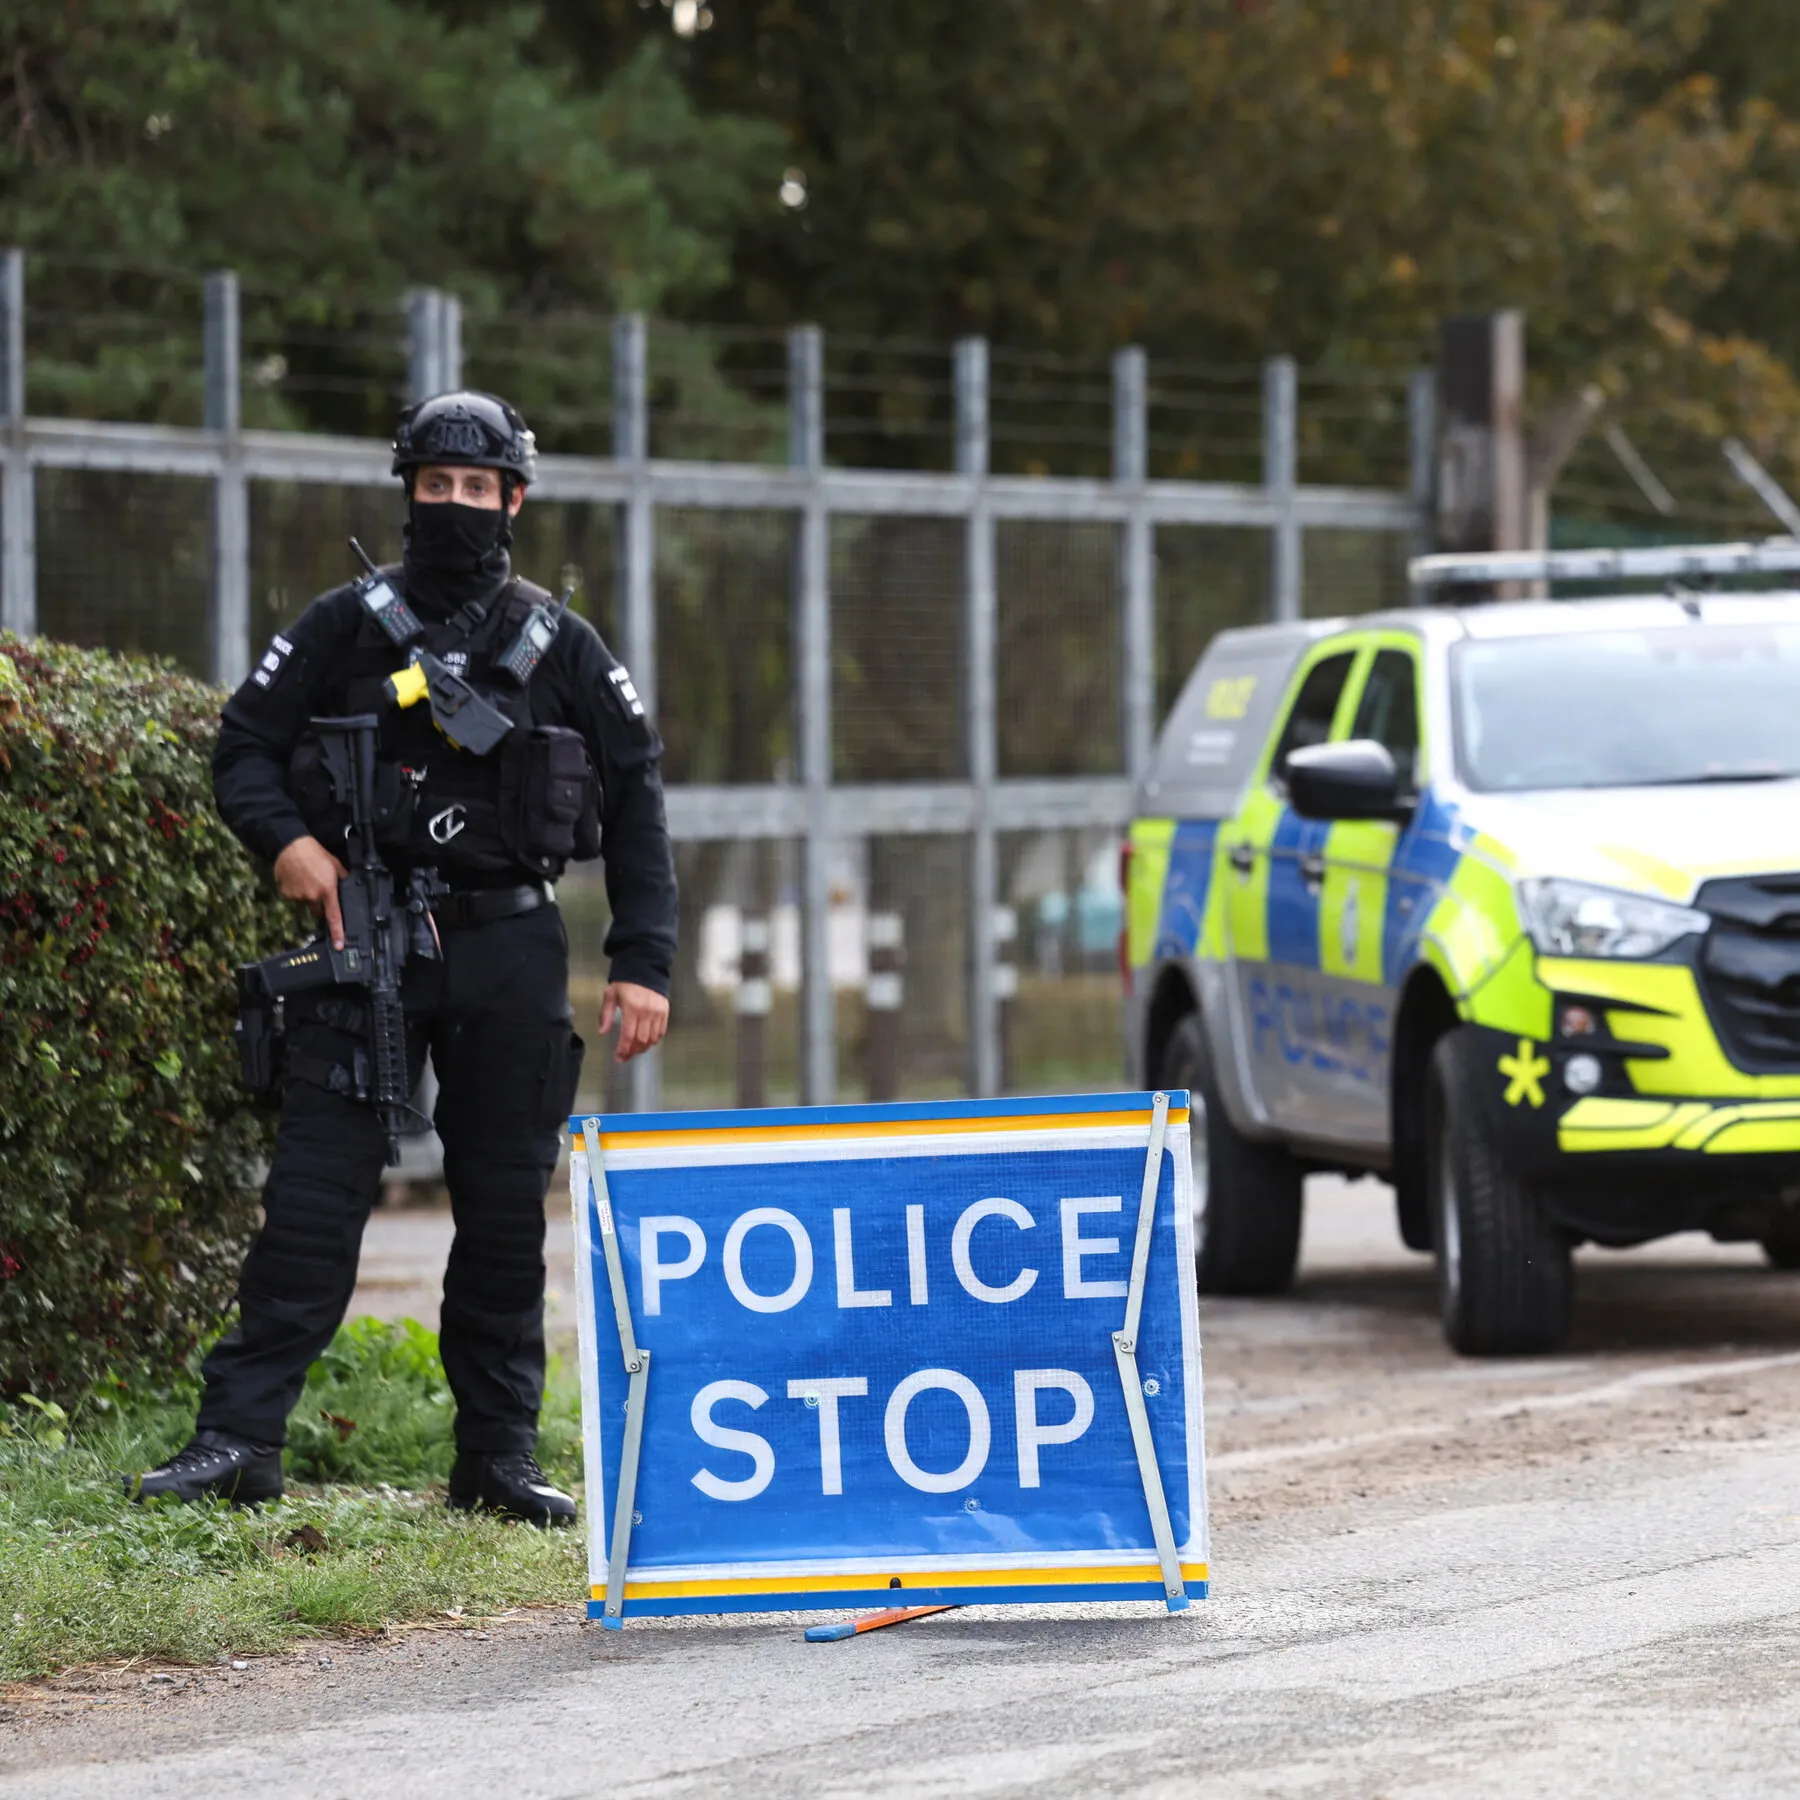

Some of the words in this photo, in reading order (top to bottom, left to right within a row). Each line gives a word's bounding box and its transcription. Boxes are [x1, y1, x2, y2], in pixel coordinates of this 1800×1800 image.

[1249, 978, 1389, 1080] POLICE
[638, 1196, 1129, 1317] POLICE
[690, 1369, 1095, 1502] STOP
